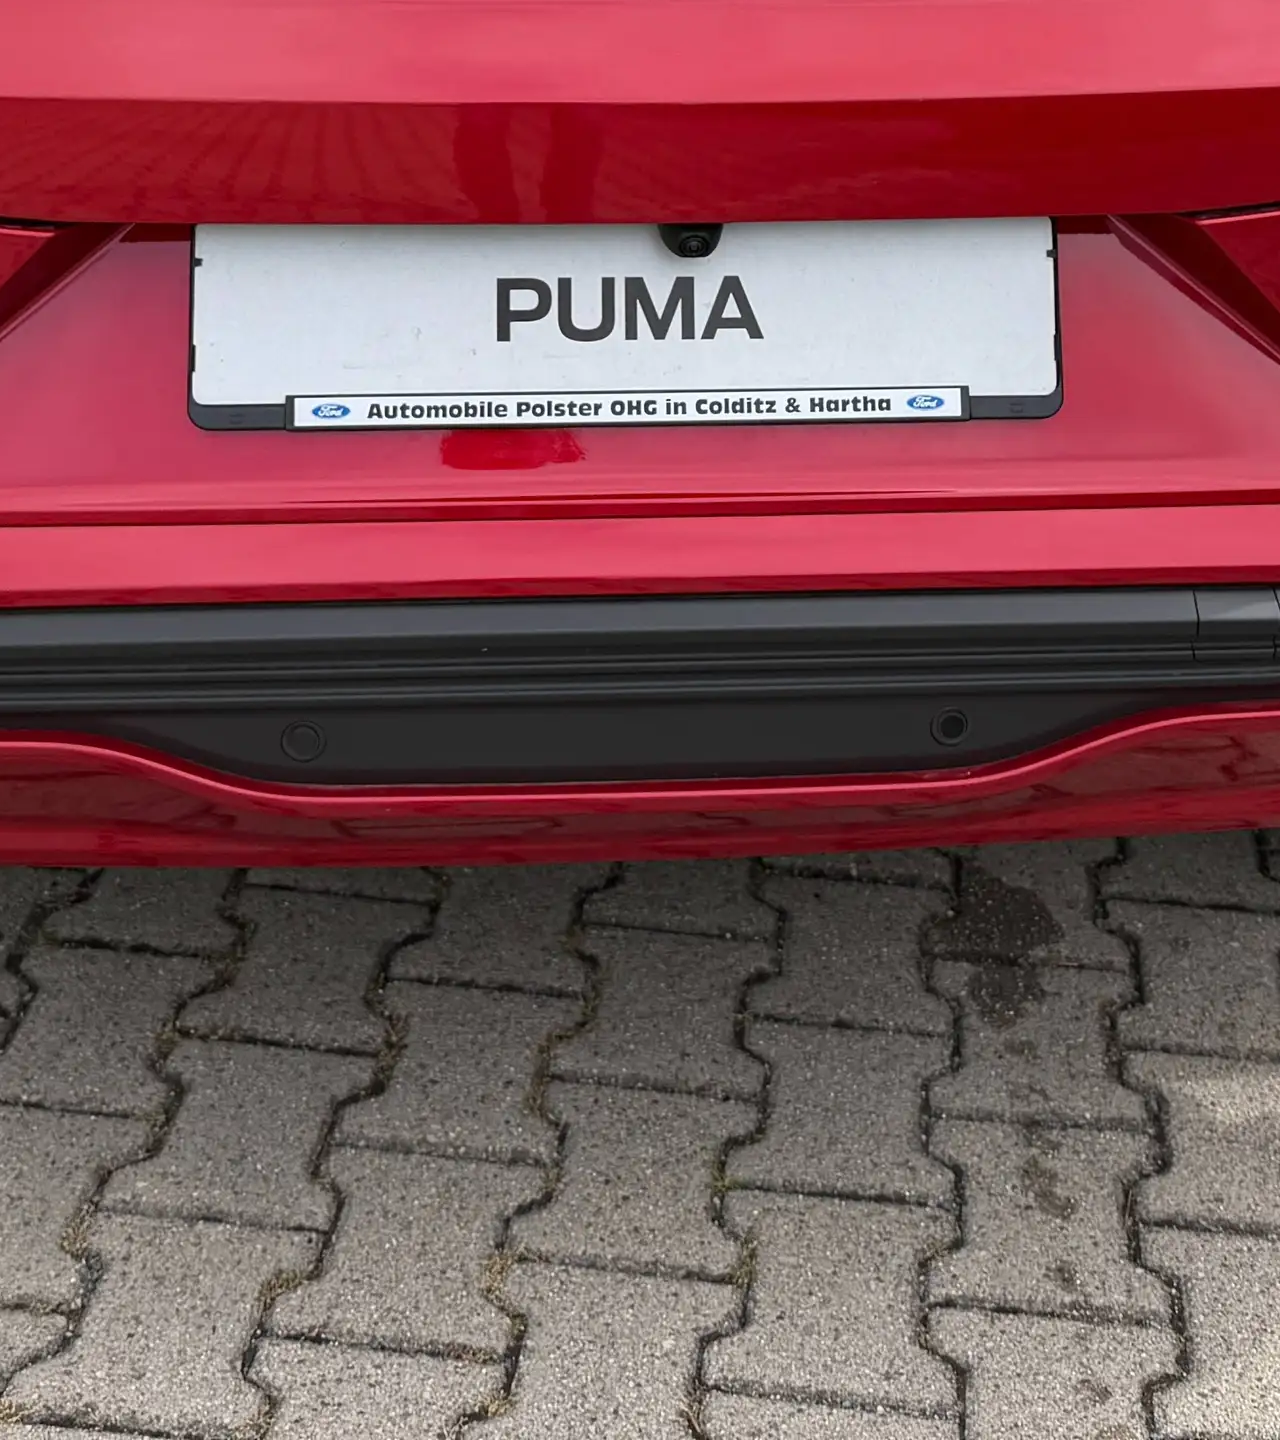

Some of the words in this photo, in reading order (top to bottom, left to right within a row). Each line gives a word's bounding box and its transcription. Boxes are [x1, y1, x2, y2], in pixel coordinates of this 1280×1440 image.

[494, 274, 765, 344] PUMA
[366, 401, 509, 420] Automobile
[516, 399, 603, 418] Polster
[610, 399, 658, 416] OHG
[665, 398, 688, 415] in
[695, 396, 777, 415] Colditz
[785, 397, 801, 413] &
[809, 396, 892, 413] Hartha
